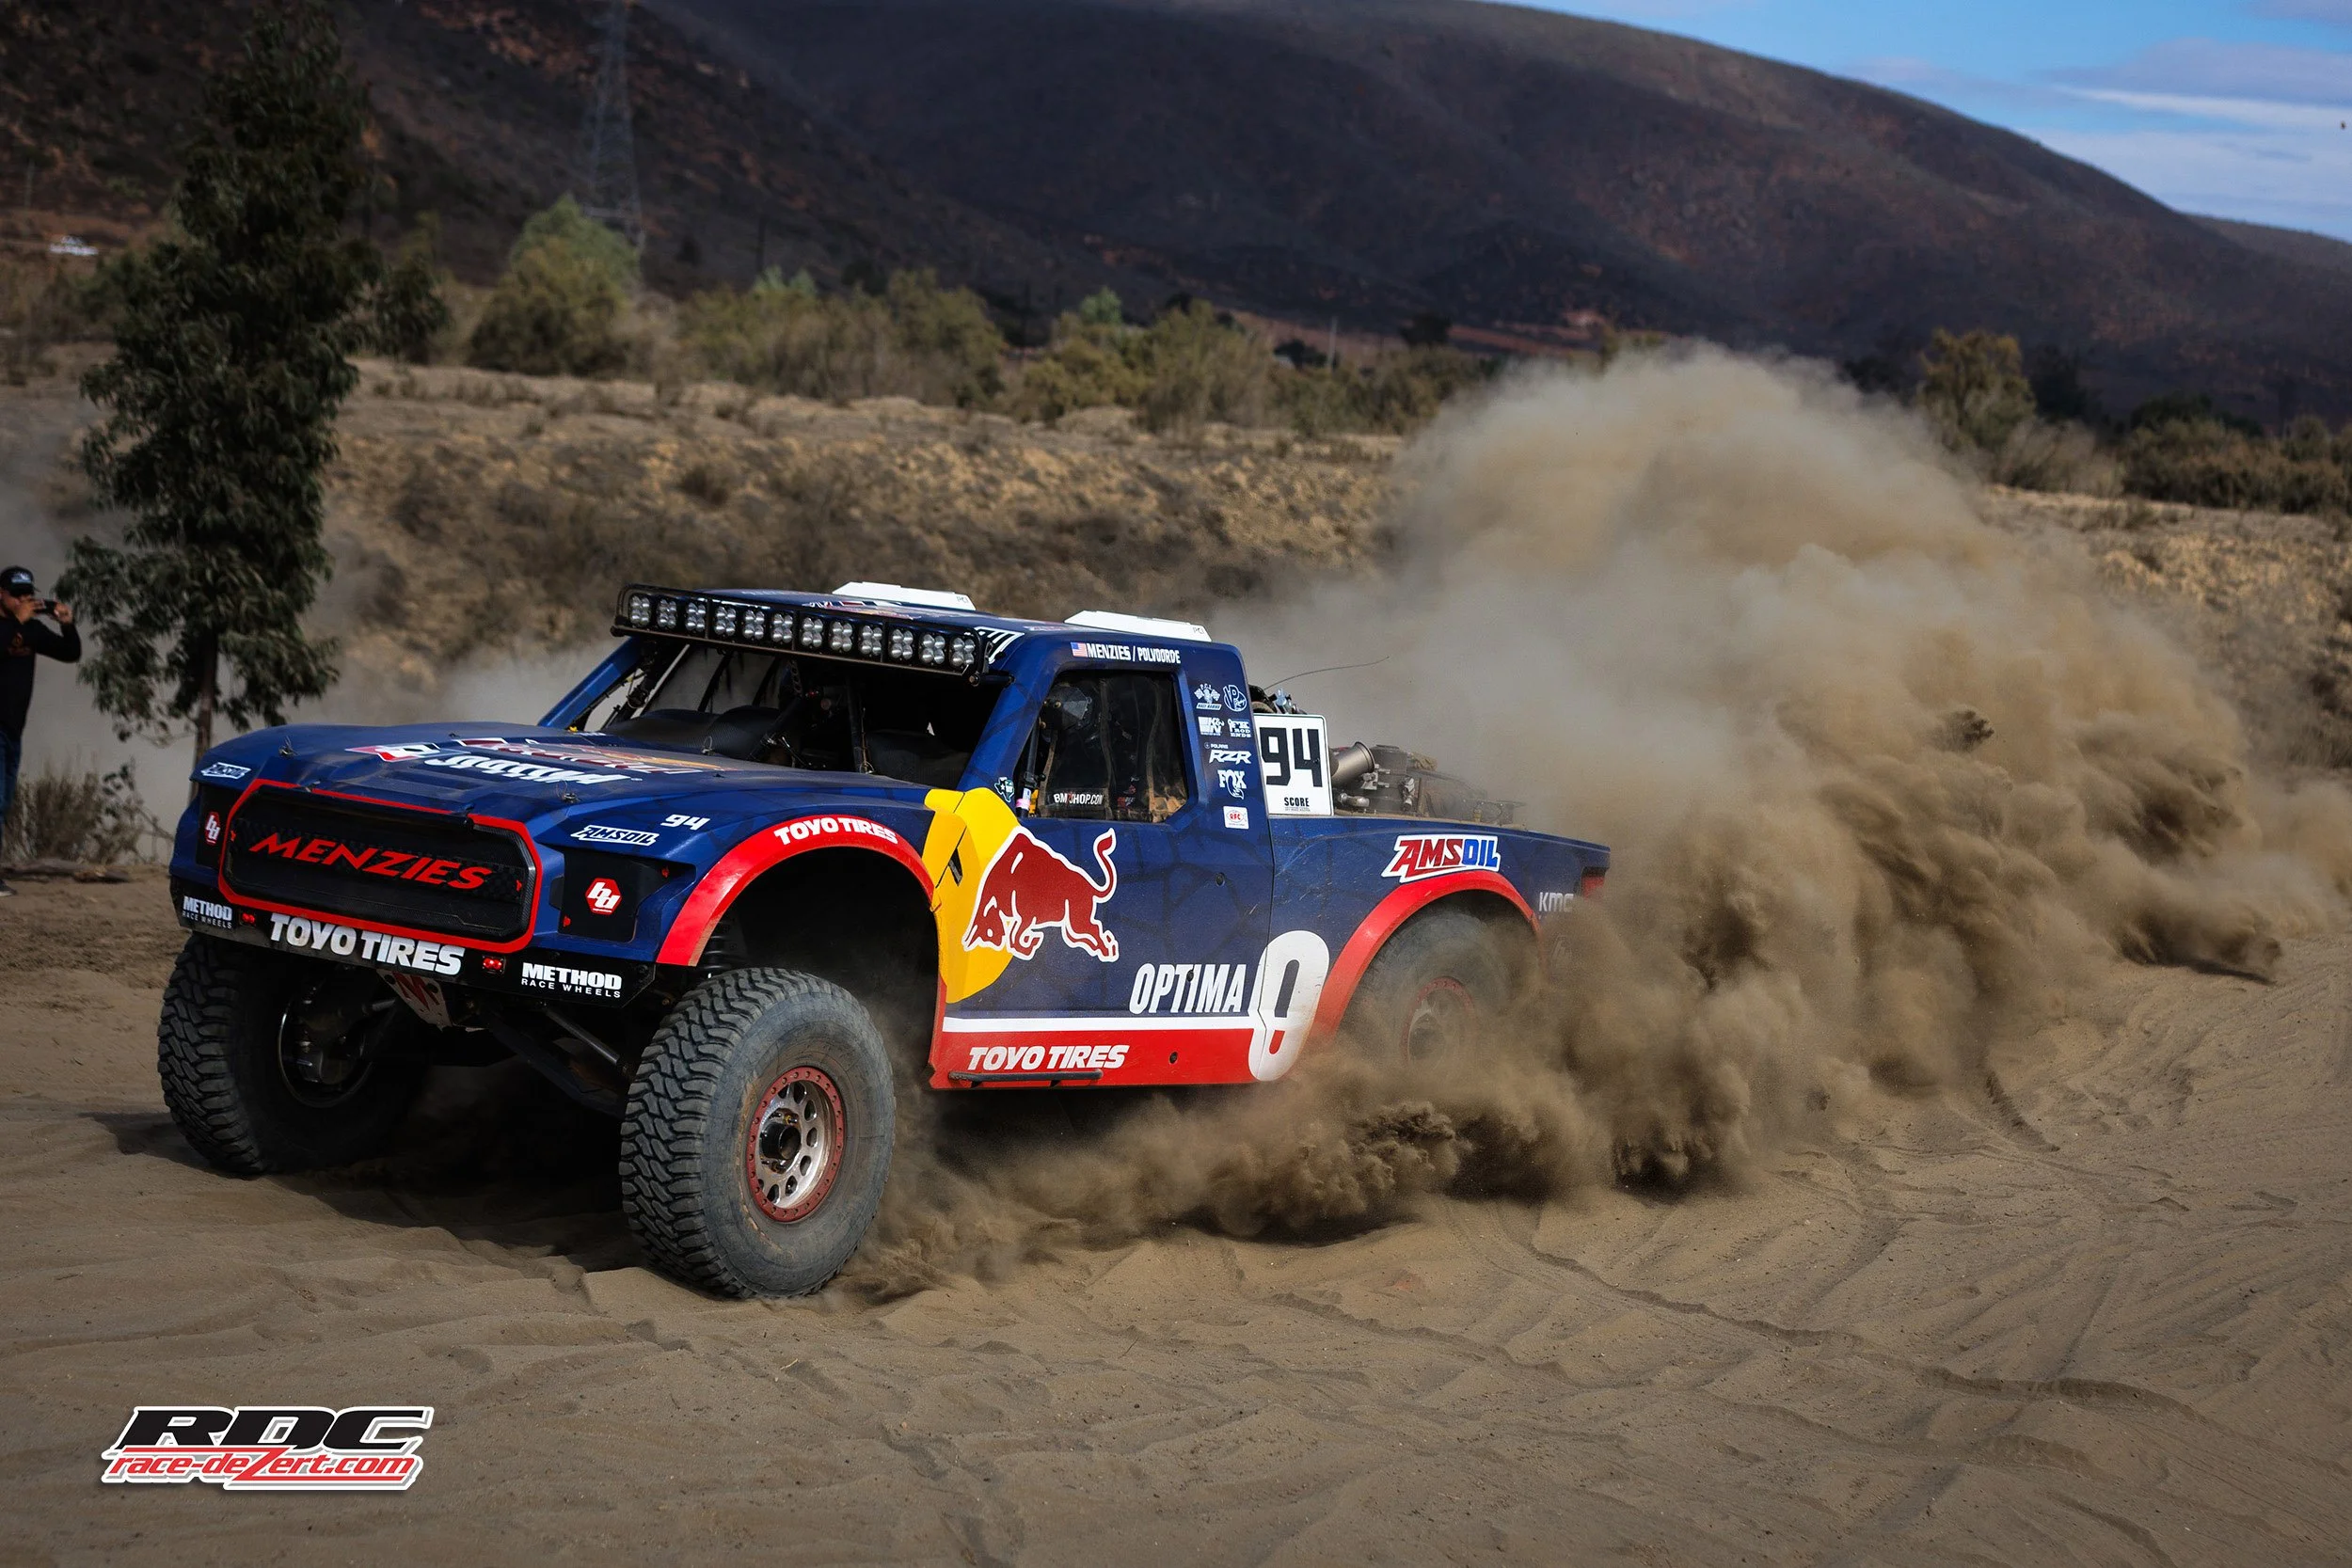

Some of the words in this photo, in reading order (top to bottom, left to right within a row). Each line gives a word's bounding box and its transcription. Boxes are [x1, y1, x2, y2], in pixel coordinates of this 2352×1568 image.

[1086, 642, 1131, 660] MENZIES
[1208, 749, 1252, 765] RZR
[1259, 727, 1323, 787] 94
[1217, 768, 1248, 800] FOX
[1284, 797, 1310, 807] SCORE
[572, 825, 660, 845] AMSOIL
[660, 814, 711, 831] 94
[773, 816, 839, 846] TOYO
[837, 816, 898, 845] TIRES
[249, 833, 493, 889] MENZIES
[1388, 838, 1501, 879] AMSOIL
[183, 895, 233, 921] METHOD
[201, 915, 233, 929] WHEELS
[270, 912, 357, 956] TOYO
[361, 930, 466, 975] TIRES
[521, 978, 555, 990] RACE
[563, 984, 621, 999] WHEELS
[522, 962, 622, 990] METHOD
[1129, 962, 1248, 1016] OPTIMA
[967, 1045, 1046, 1070] TOYO
[1046, 1044, 1130, 1069] TIRES
